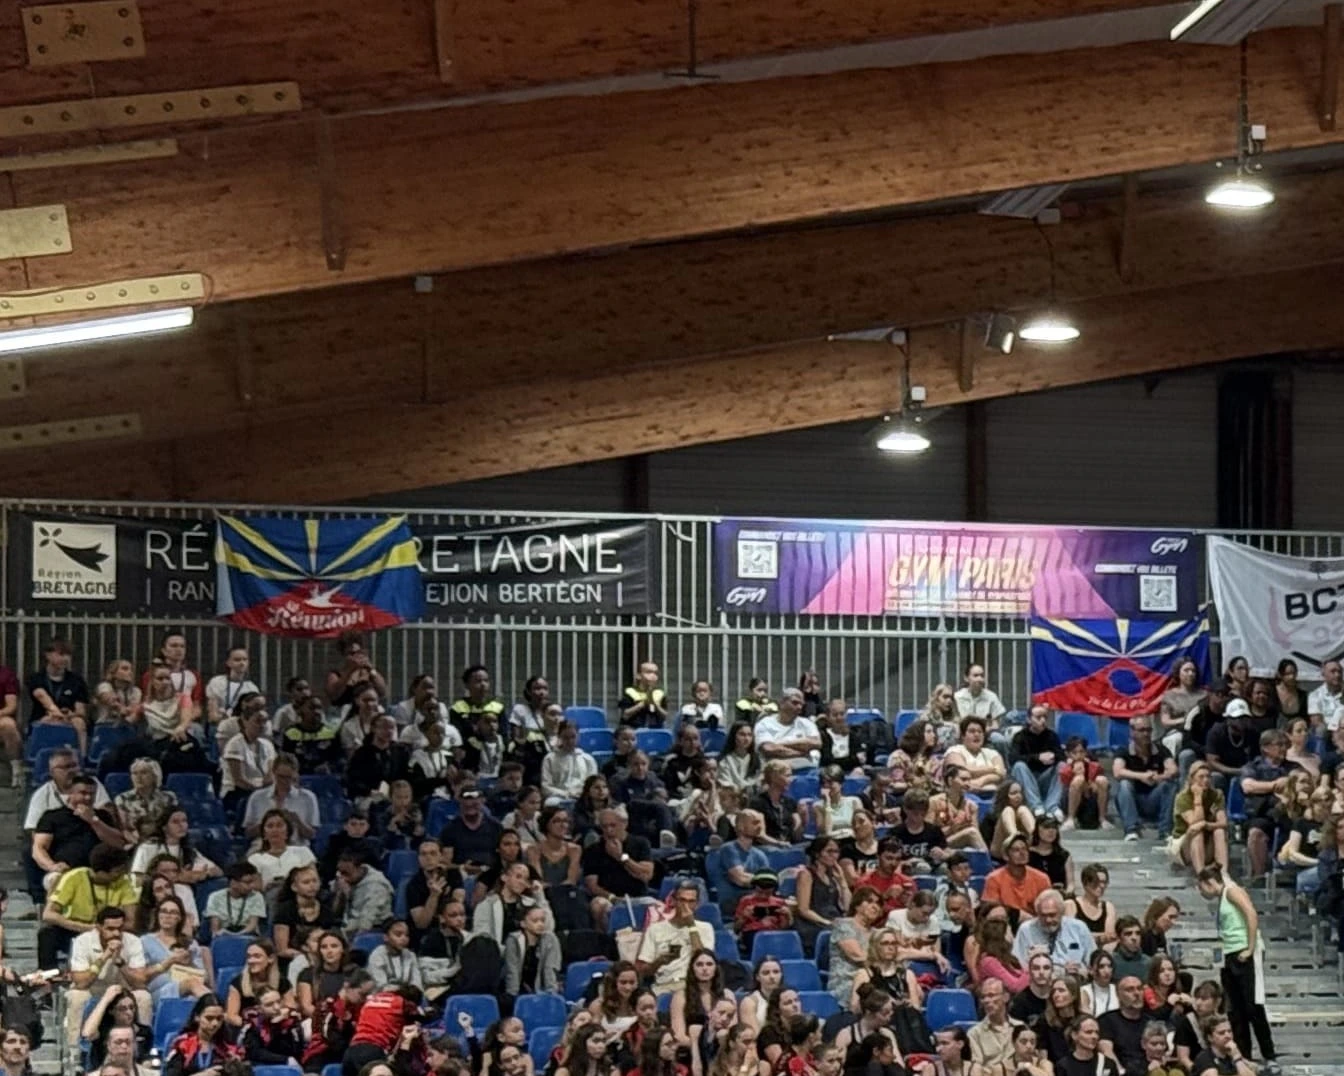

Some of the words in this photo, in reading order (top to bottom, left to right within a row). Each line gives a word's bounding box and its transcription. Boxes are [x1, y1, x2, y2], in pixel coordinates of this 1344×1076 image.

[146, 524, 209, 571] RÉ
[412, 534, 623, 573] RETAGNE
[889, 554, 954, 588] GYM
[958, 555, 1036, 589] PARIS
[168, 580, 214, 601] RAN
[426, 582, 488, 604] EJION
